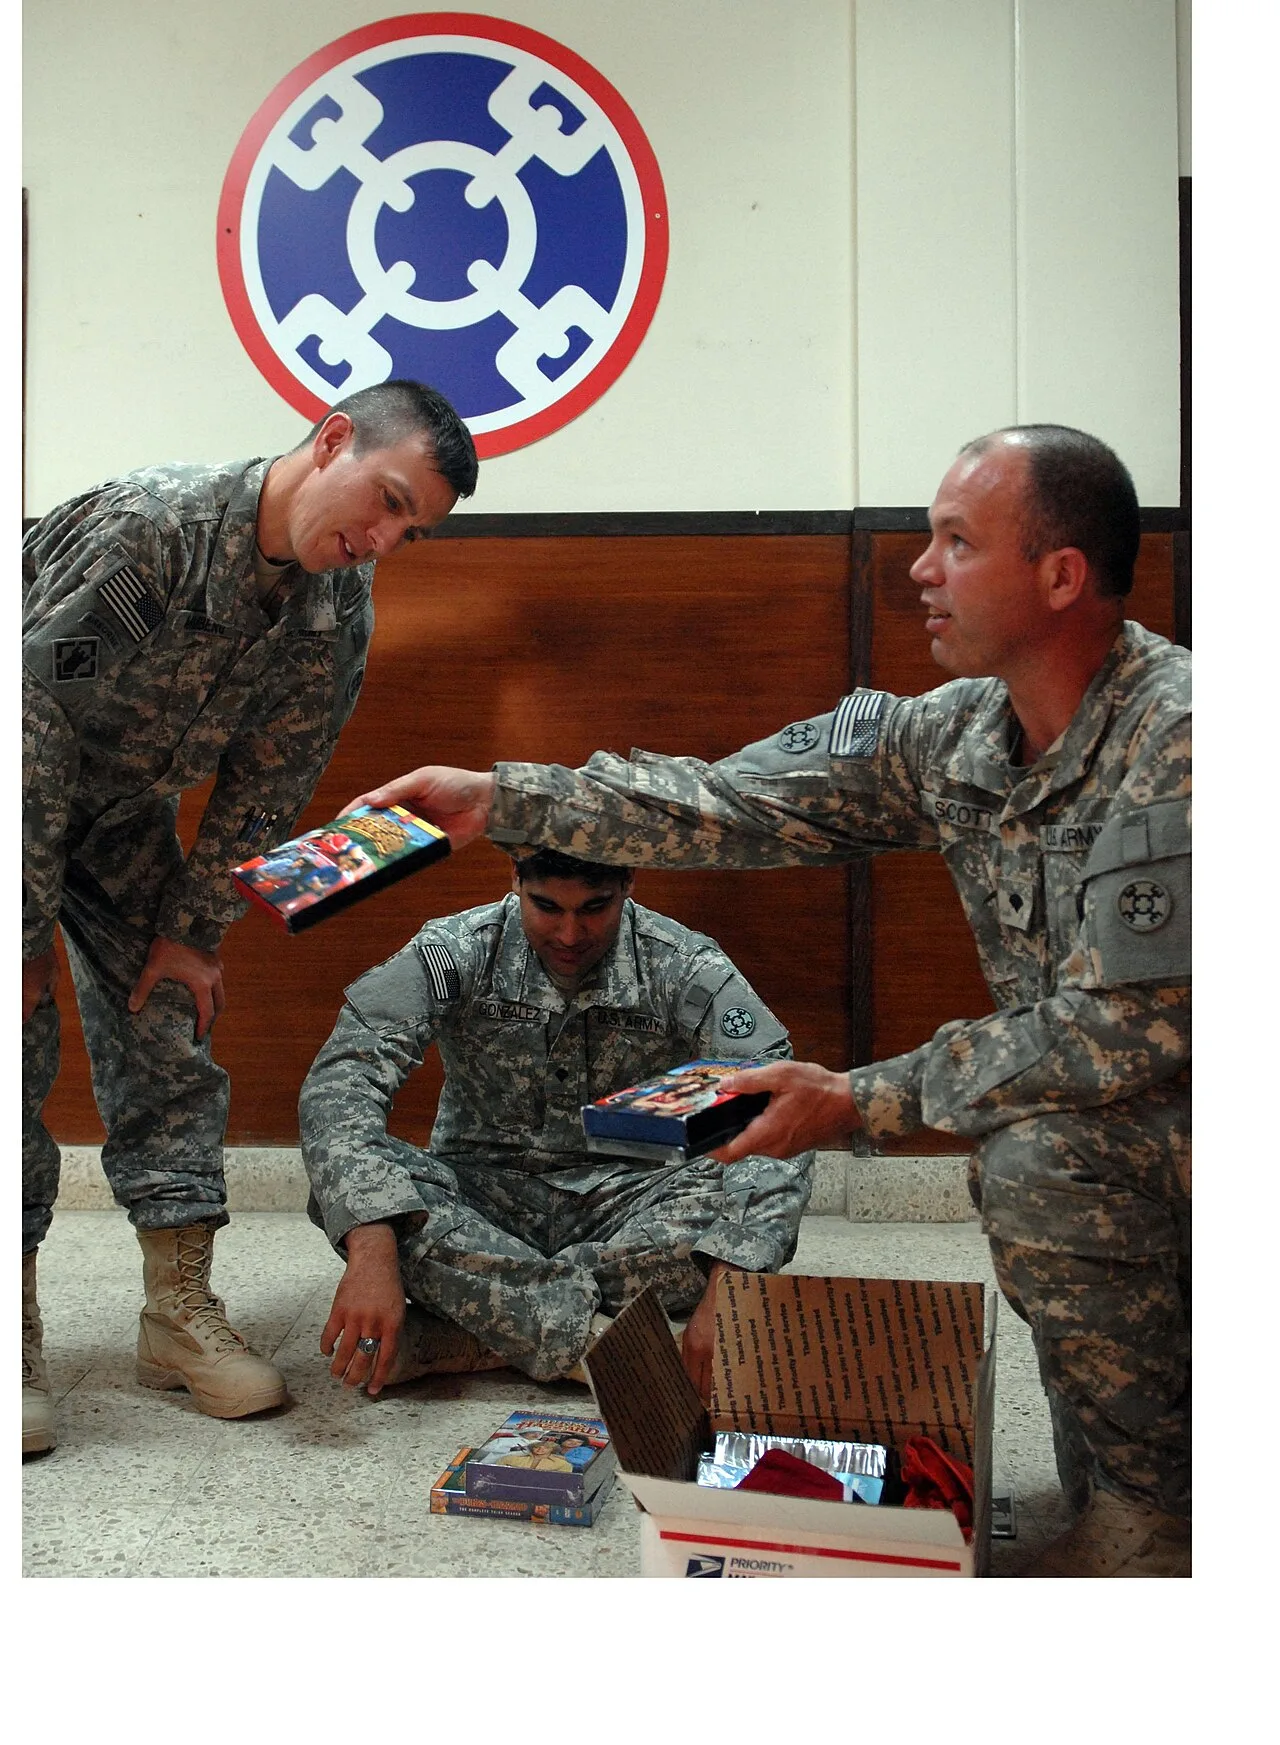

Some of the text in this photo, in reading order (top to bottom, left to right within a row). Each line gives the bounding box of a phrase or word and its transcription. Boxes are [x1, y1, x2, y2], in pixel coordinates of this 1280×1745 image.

[934, 801, 993, 828] SCOTT
[478, 1002, 541, 1021] GONZALEZ
[624, 1016, 660, 1032] ARMY
[727, 1286, 736, 1307] using
[791, 1276, 800, 1298] using
[911, 1282, 920, 1313] Service
[929, 1293, 938, 1307] you
[762, 1297, 772, 1327] Priority
[826, 1286, 837, 1316] Priority
[845, 1293, 855, 1324] Service
[863, 1304, 872, 1318] you
[944, 1288, 957, 1322] required
[716, 1313, 725, 1343] Service
[780, 1303, 789, 1333] Service
[798, 1314, 807, 1328] you
[814, 1309, 825, 1343] required
[879, 1299, 891, 1333] required
[897, 1308, 908, 1330] using
[933, 1310, 943, 1335] Thank
[734, 1323, 742, 1338] you
[748, 1319, 760, 1353] required
[767, 1329, 778, 1351] using
[832, 1319, 842, 1340] using
[866, 1320, 875, 1346] Thank
[953, 1324, 965, 1358] postage
[735, 1340, 745, 1365] Thank
[800, 1331, 810, 1356] Thank
[836, 1343, 844, 1355] for
[887, 1336, 899, 1368] postage
[906, 1347, 915, 1362] you
[920, 1338, 932, 1369] Priority
[755, 1355, 767, 1388] postage
[774, 1367, 783, 1382] you
[788, 1359, 800, 1389] Priority
[820, 1345, 832, 1378] postage
[839, 1357, 849, 1372] you
[855, 1349, 866, 1379] Priority
[724, 1368, 734, 1398] Priority
[843, 1374, 851, 1400] Thank
[910, 1364, 919, 1391] Thank
[928, 1371, 937, 1394] using
[942, 1365, 957, 1401] required
[776, 1384, 786, 1410] Thank
[794, 1391, 804, 1413] using
[860, 1381, 870, 1404] using
[876, 1375, 888, 1410] required
